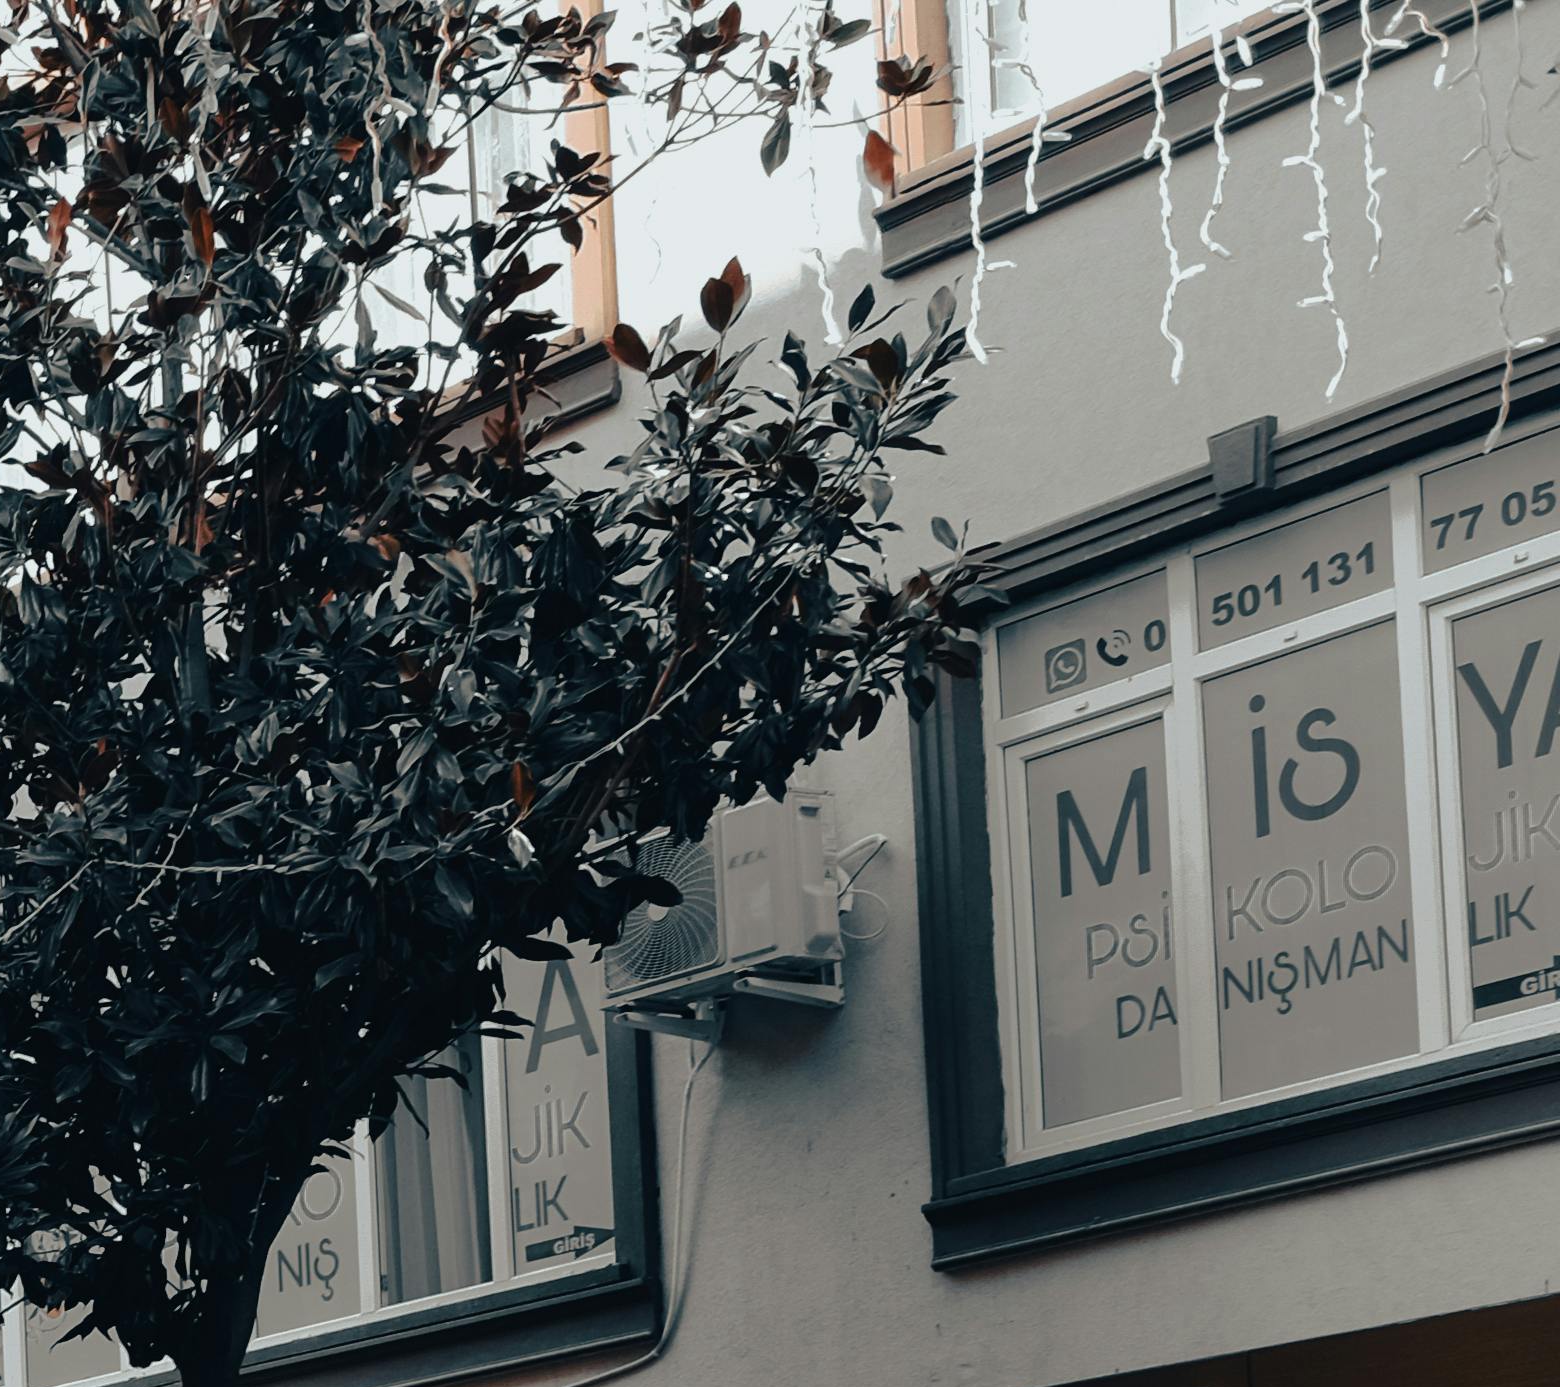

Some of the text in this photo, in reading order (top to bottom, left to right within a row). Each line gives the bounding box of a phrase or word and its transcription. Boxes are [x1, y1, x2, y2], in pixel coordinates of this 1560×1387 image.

[1211, 573, 1282, 627] 501
[1300, 541, 1377, 595] 131
[1430, 503, 1485, 551] 77
[1501, 480, 1558, 526] 05
[553, 1232, 596, 1257] GİRİŞ
